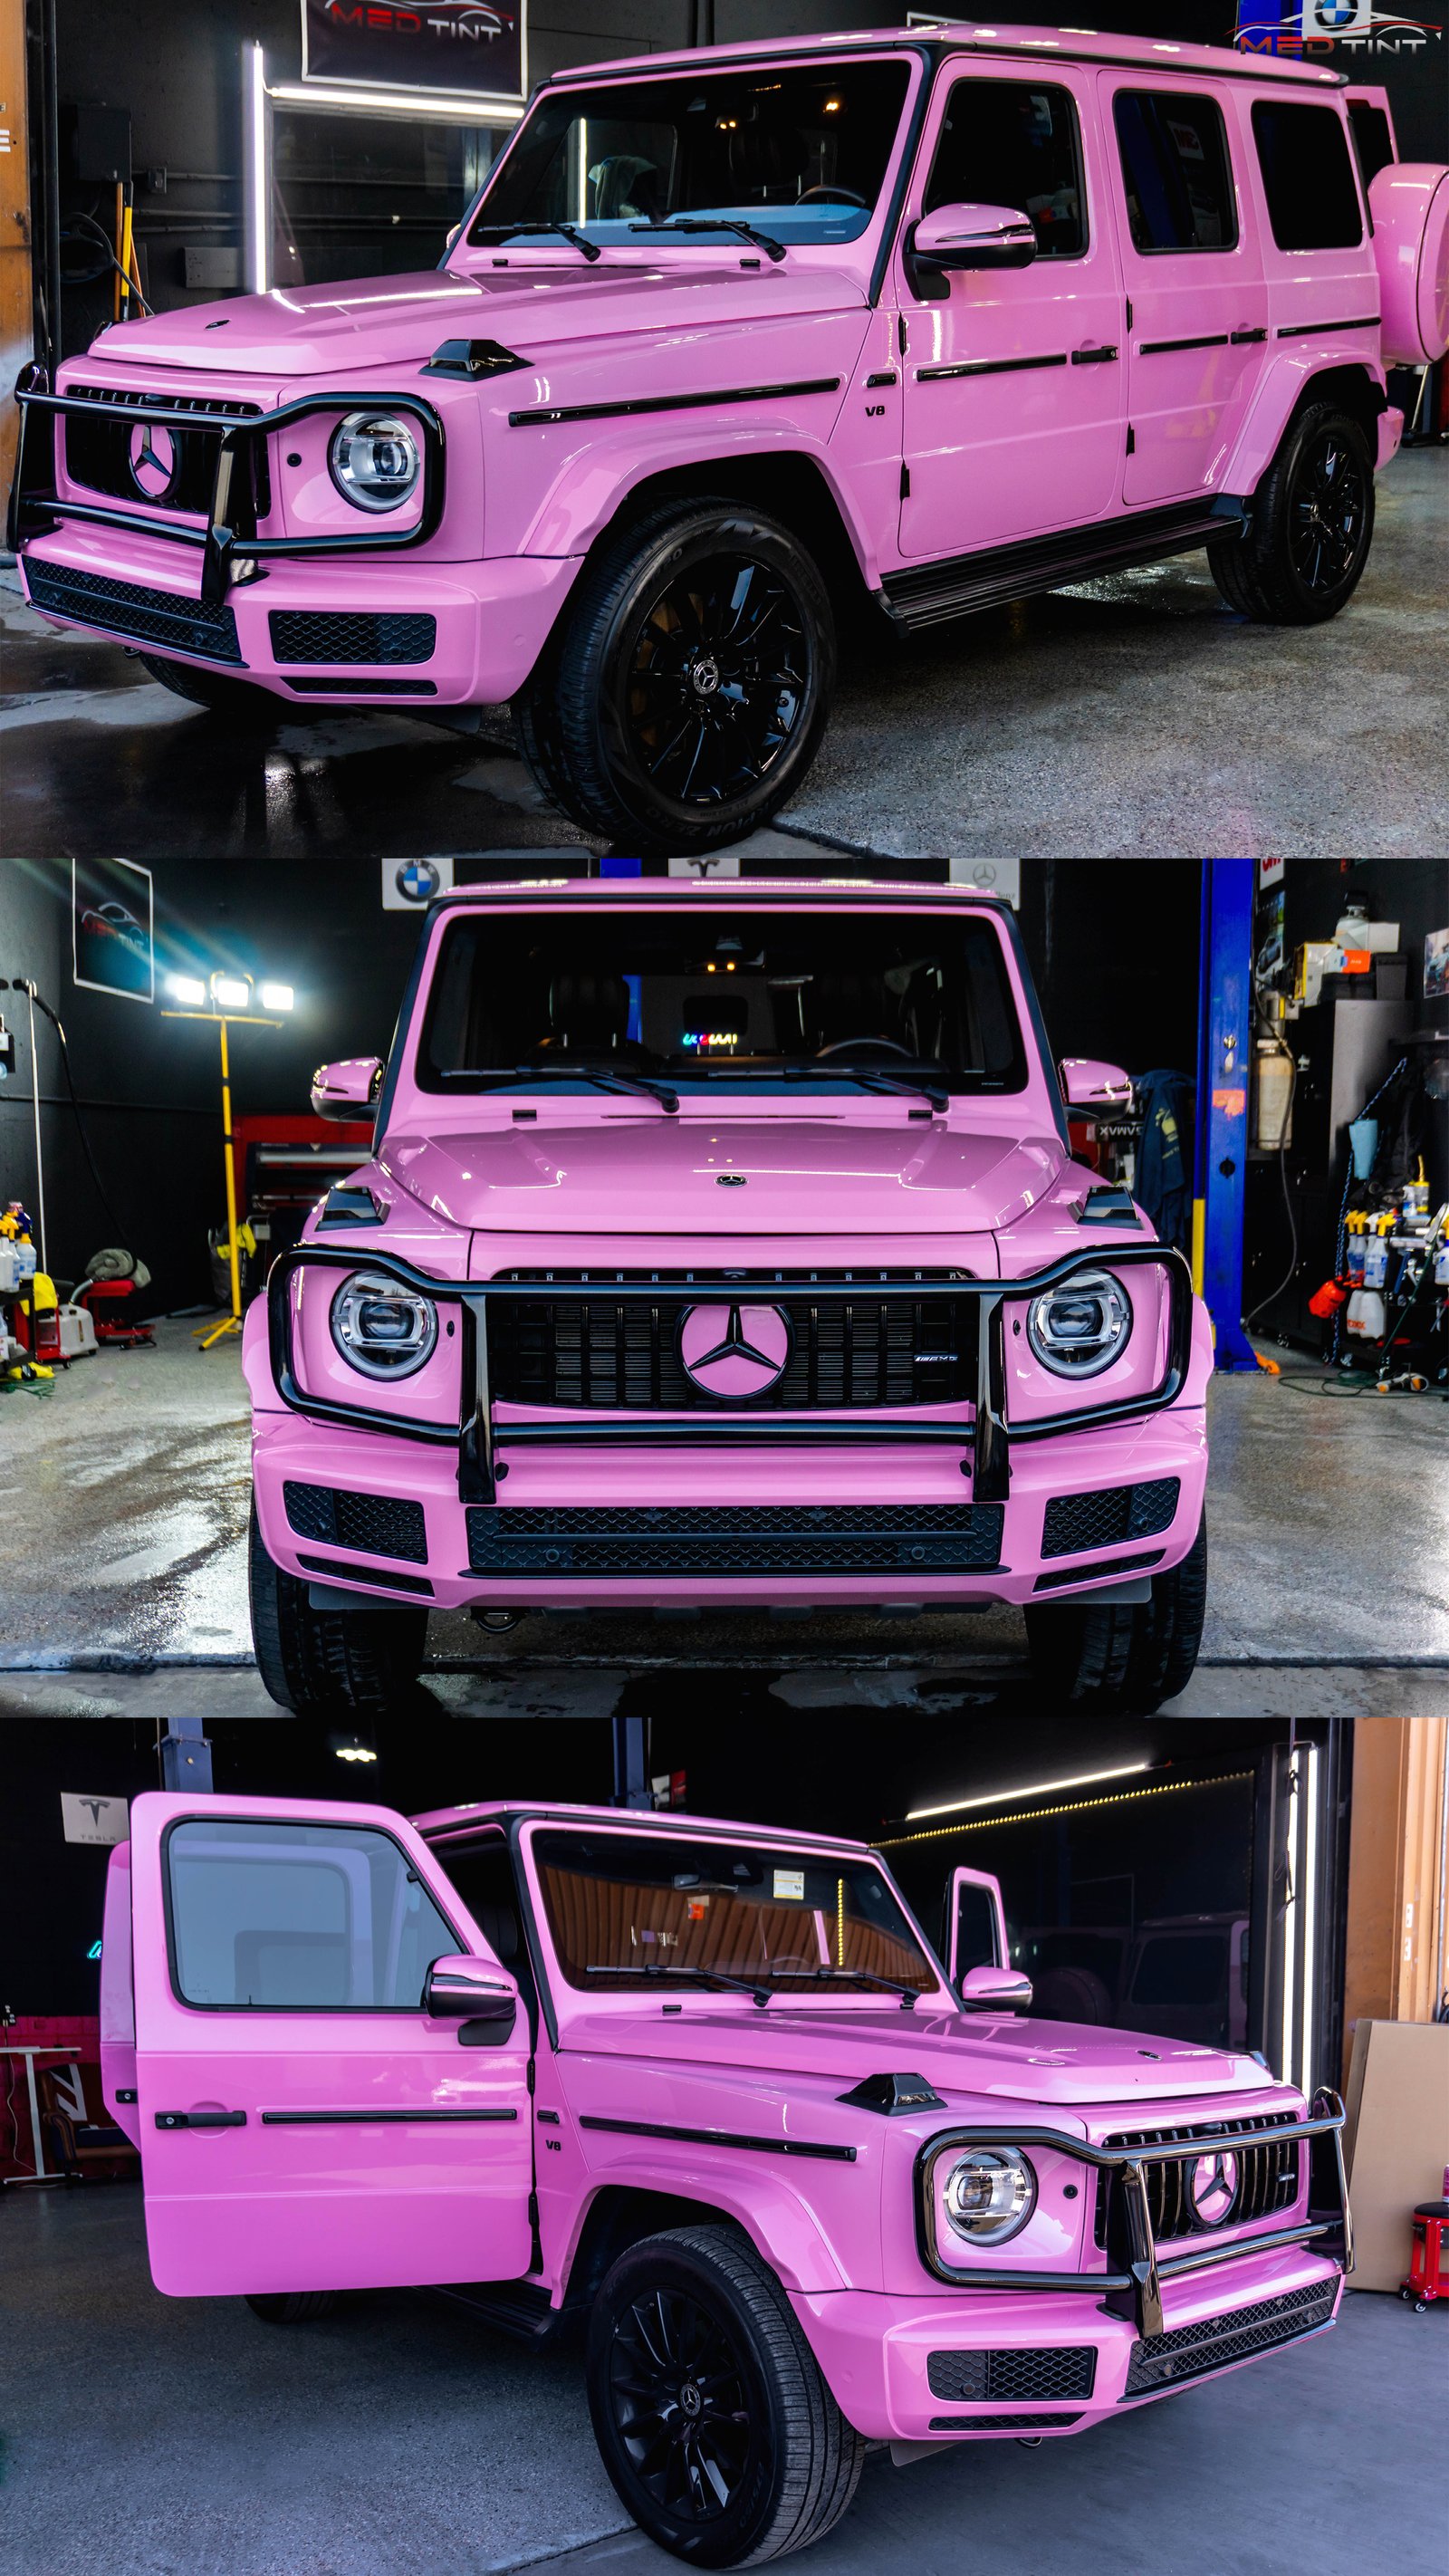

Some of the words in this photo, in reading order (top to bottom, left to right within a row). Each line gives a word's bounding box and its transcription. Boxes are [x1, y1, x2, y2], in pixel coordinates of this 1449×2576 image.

[331, 4, 421, 34] MED
[427, 18, 502, 43] TINT
[865, 405, 885, 418] V8
[545, 2139, 561, 2151] V8
